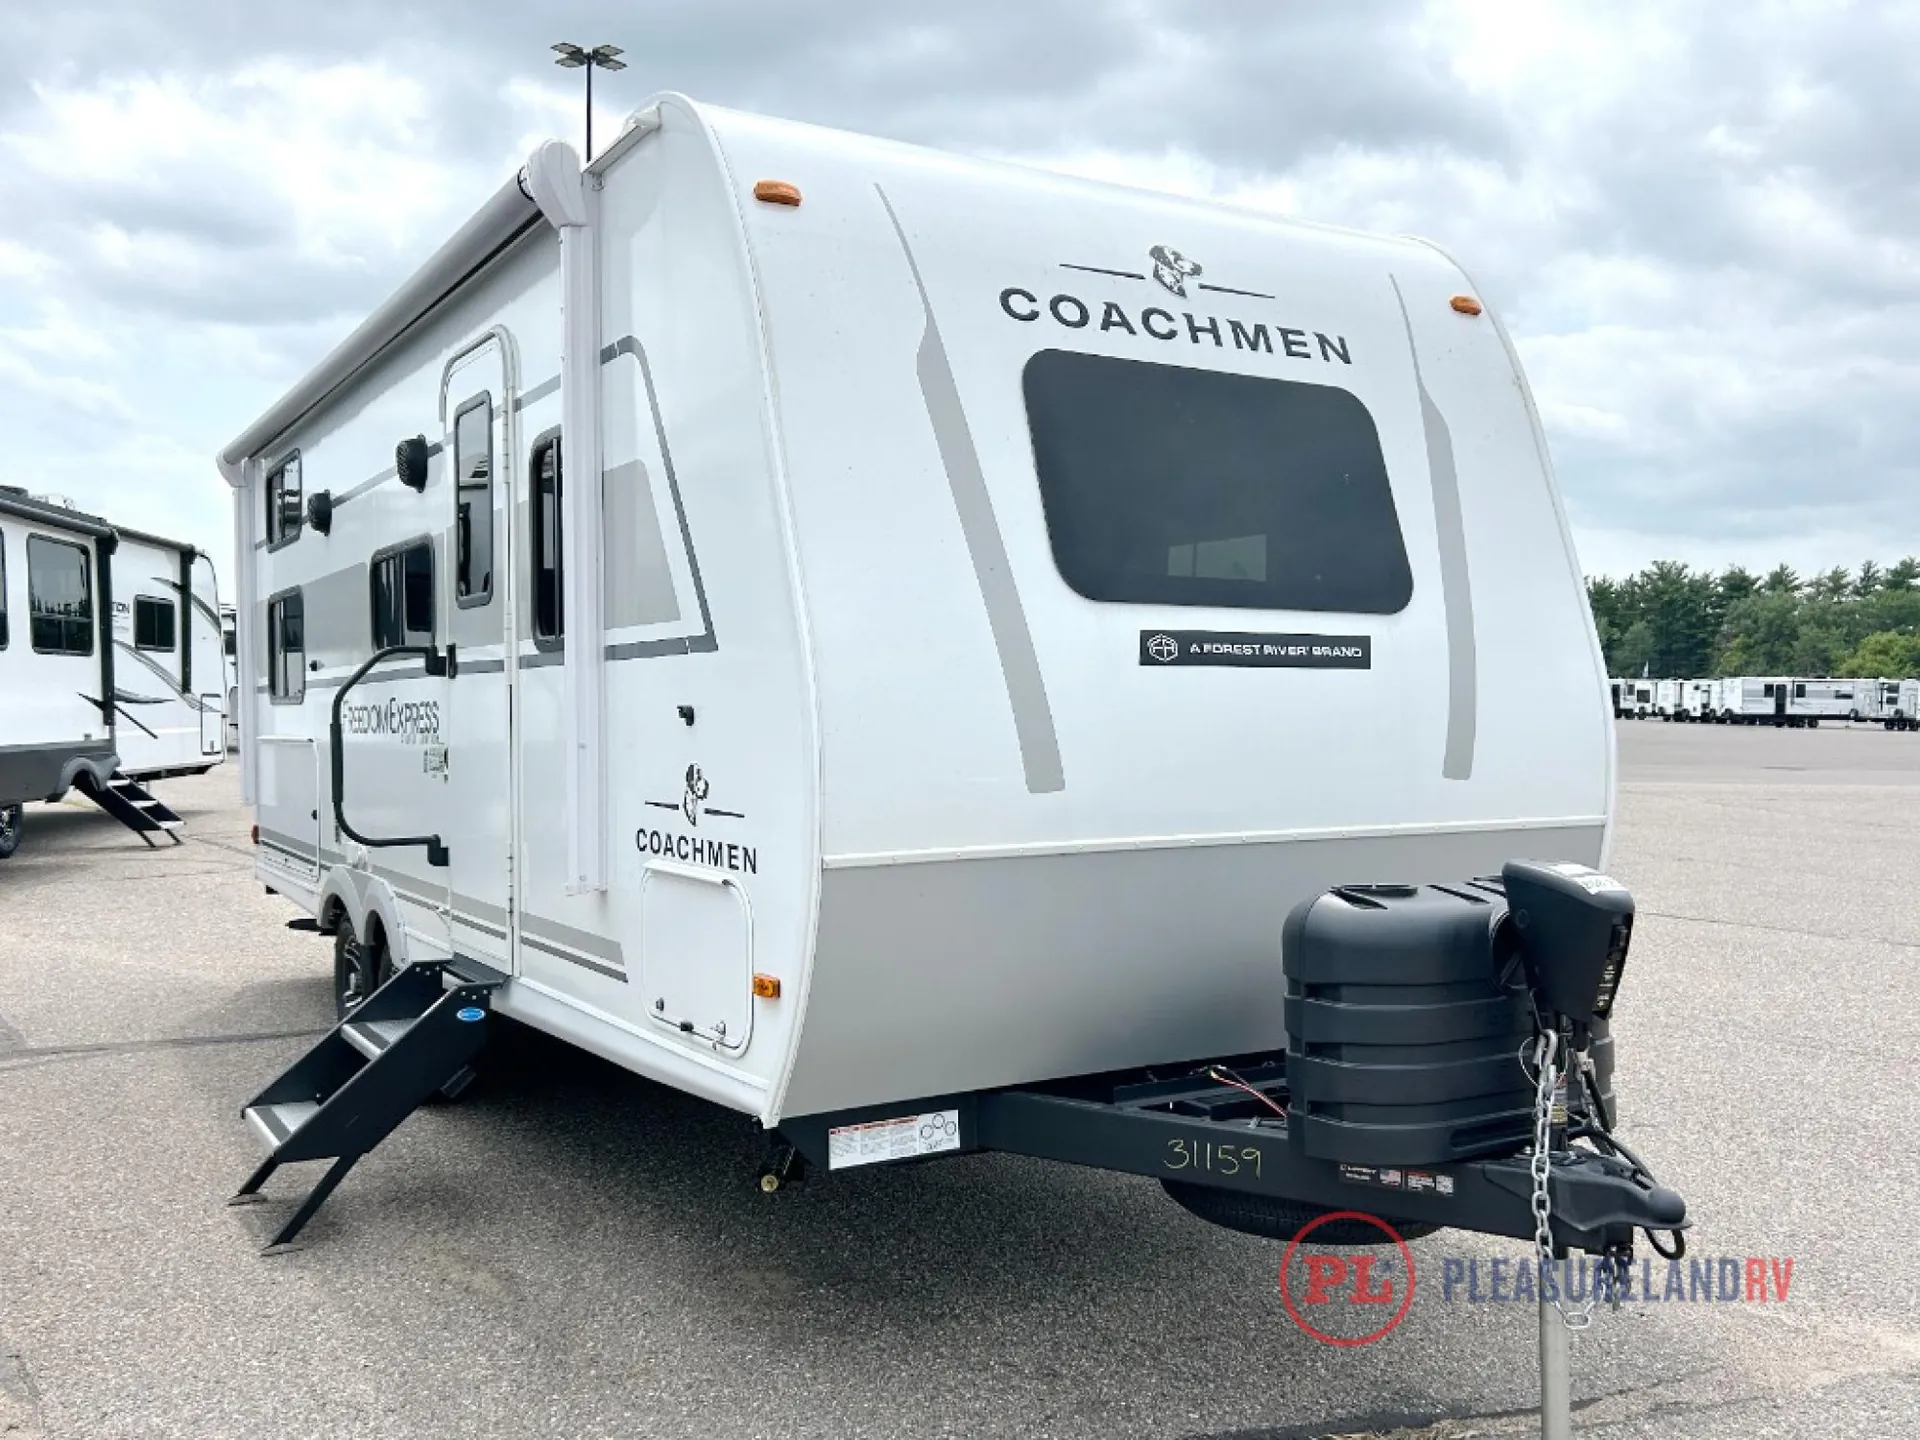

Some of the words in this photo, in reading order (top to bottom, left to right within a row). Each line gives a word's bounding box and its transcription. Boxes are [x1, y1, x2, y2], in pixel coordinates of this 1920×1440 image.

[998, 286, 1353, 365] COACHMEN
[1189, 642, 1201, 654] A
[1203, 643, 1261, 656] FOREST
[1312, 646, 1363, 658] BRAND
[635, 827, 758, 875] COACHMEN
[1163, 1138, 1262, 1181] 31159
